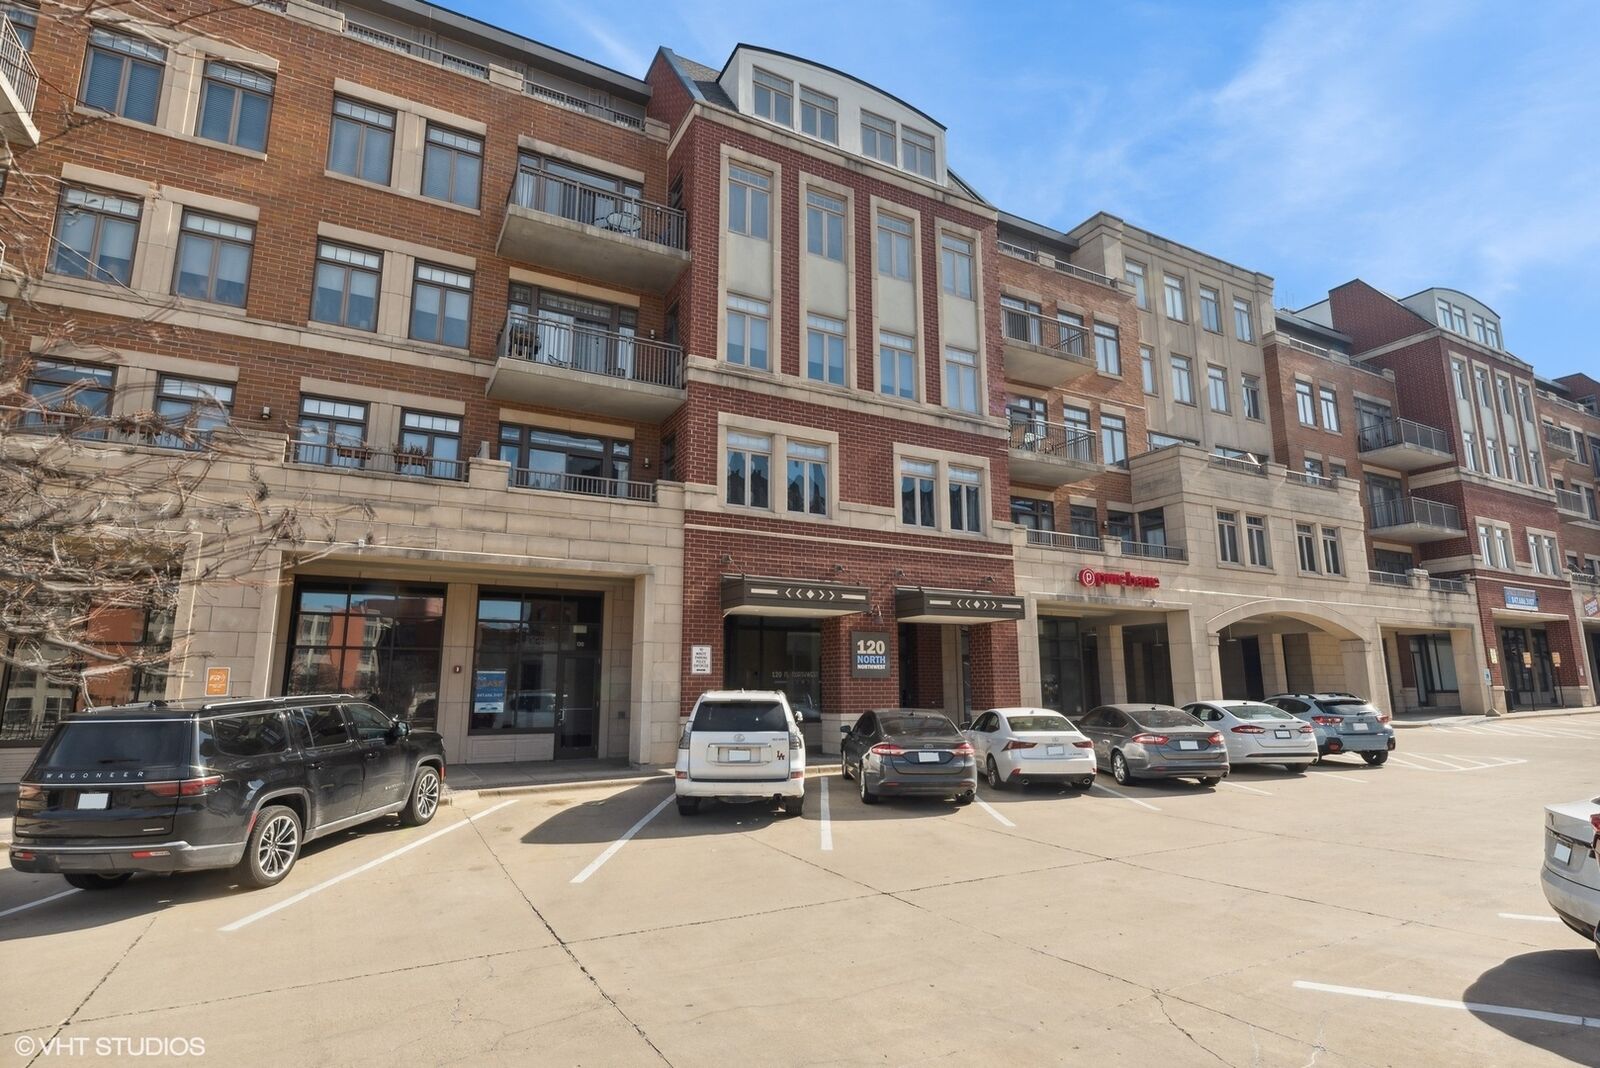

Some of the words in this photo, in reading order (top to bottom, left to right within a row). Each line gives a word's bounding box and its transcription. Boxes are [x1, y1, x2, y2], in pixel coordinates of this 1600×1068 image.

[857, 639, 886, 655] 120
[857, 655, 886, 664] NORTH
[46, 771, 144, 779] WAGONEER
